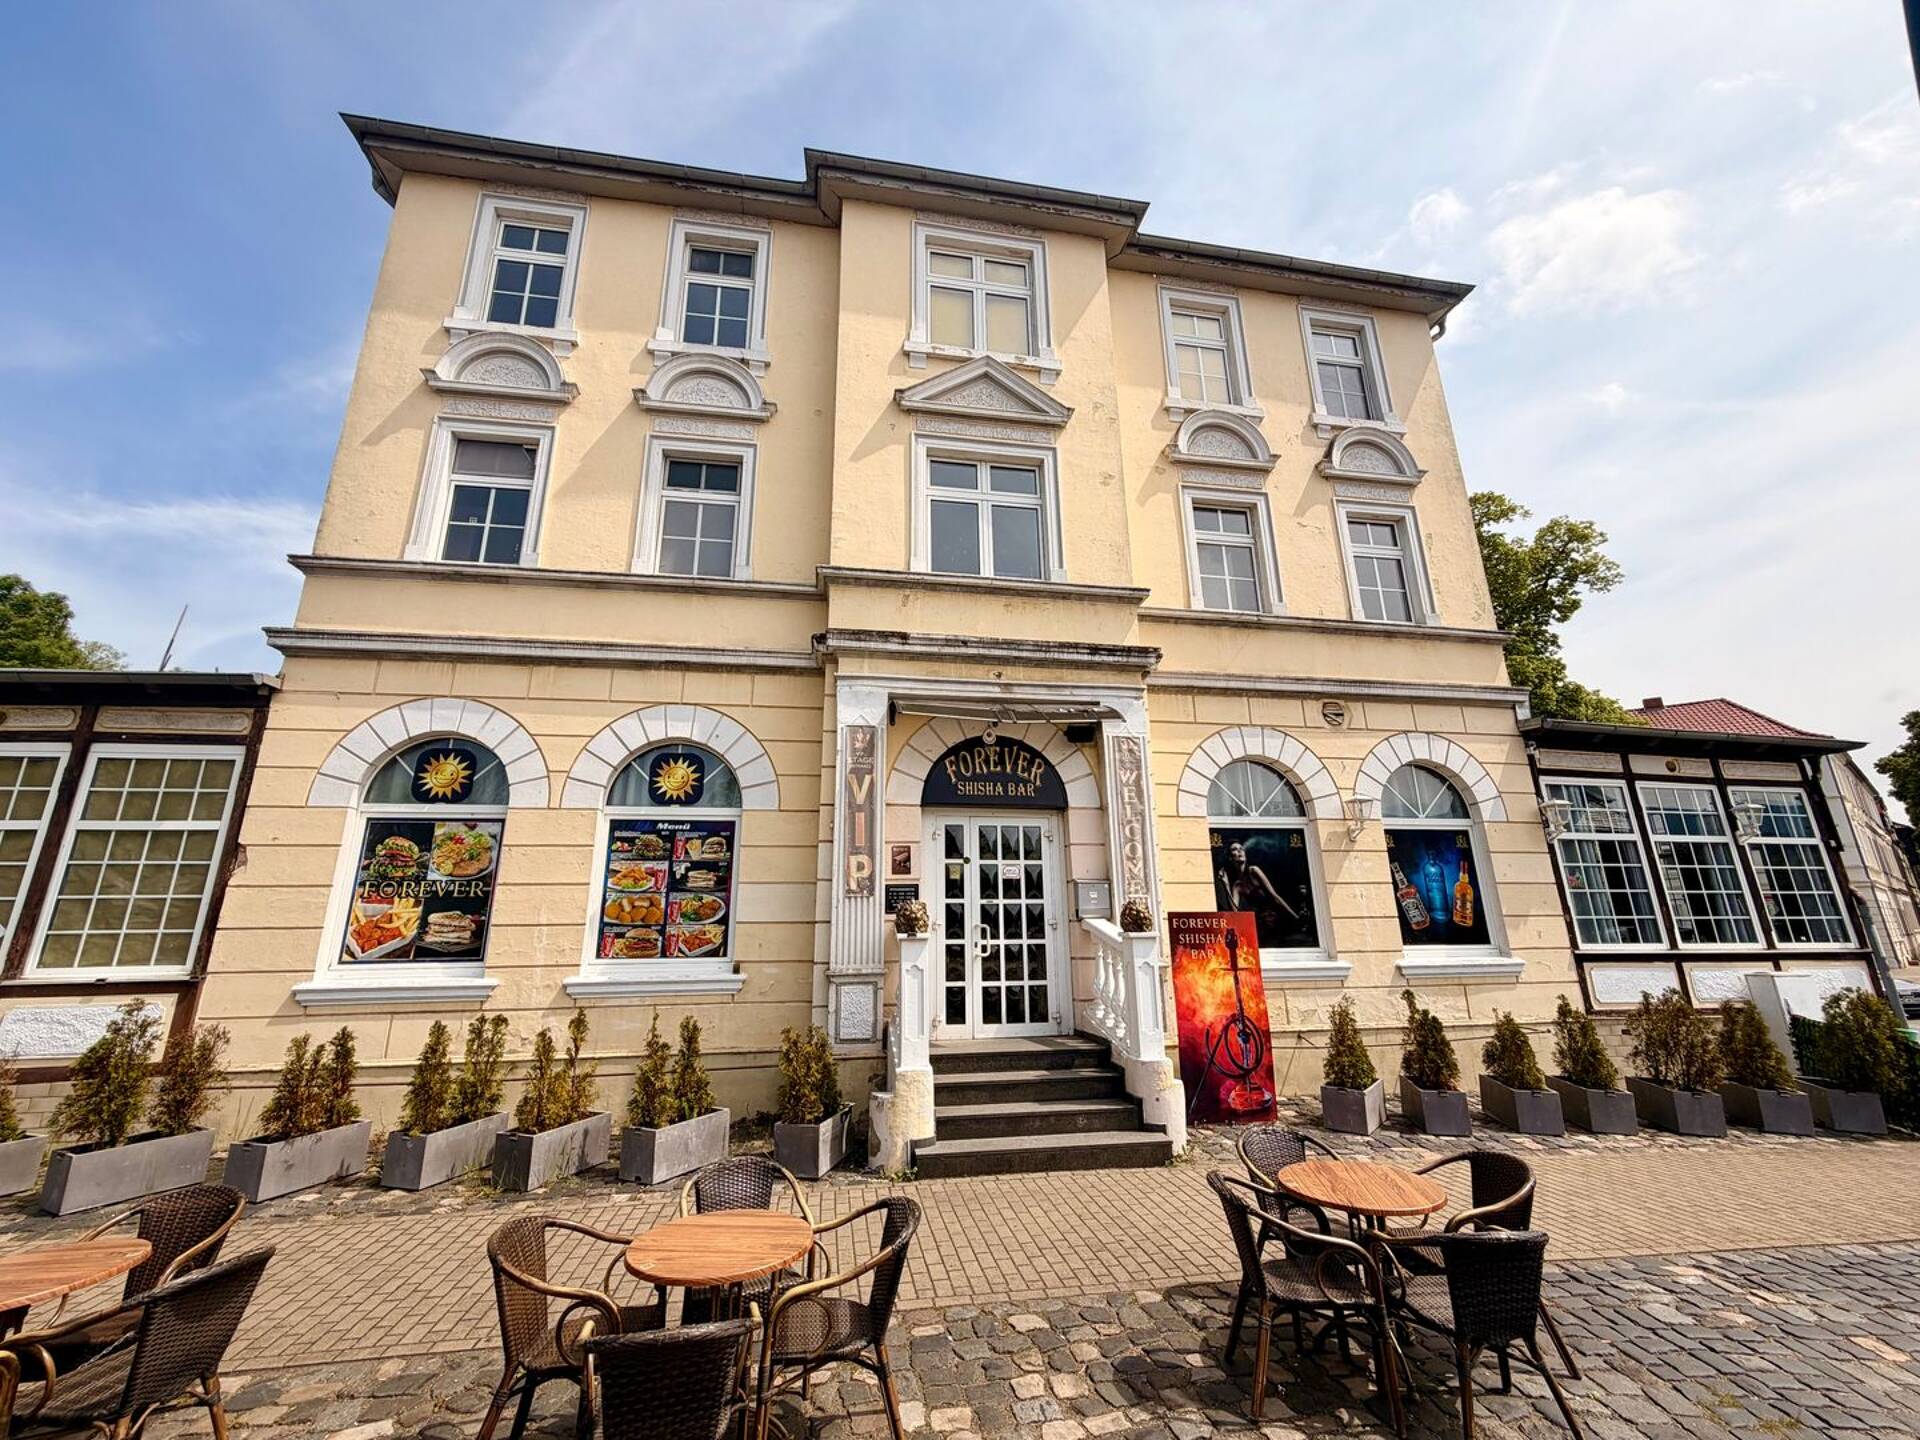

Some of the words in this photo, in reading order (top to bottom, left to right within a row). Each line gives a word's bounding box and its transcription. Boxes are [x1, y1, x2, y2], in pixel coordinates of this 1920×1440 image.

[944, 745, 1045, 787] FOREVER
[957, 781, 1004, 796] SHISHA
[1008, 783, 1035, 797] BAR
[848, 774, 873, 891] VIP
[362, 880, 484, 898] FOREVER
[1172, 918, 1228, 929] FOREVER
[1179, 933, 1224, 944] SHISHA
[1191, 949, 1214, 960] BAR
